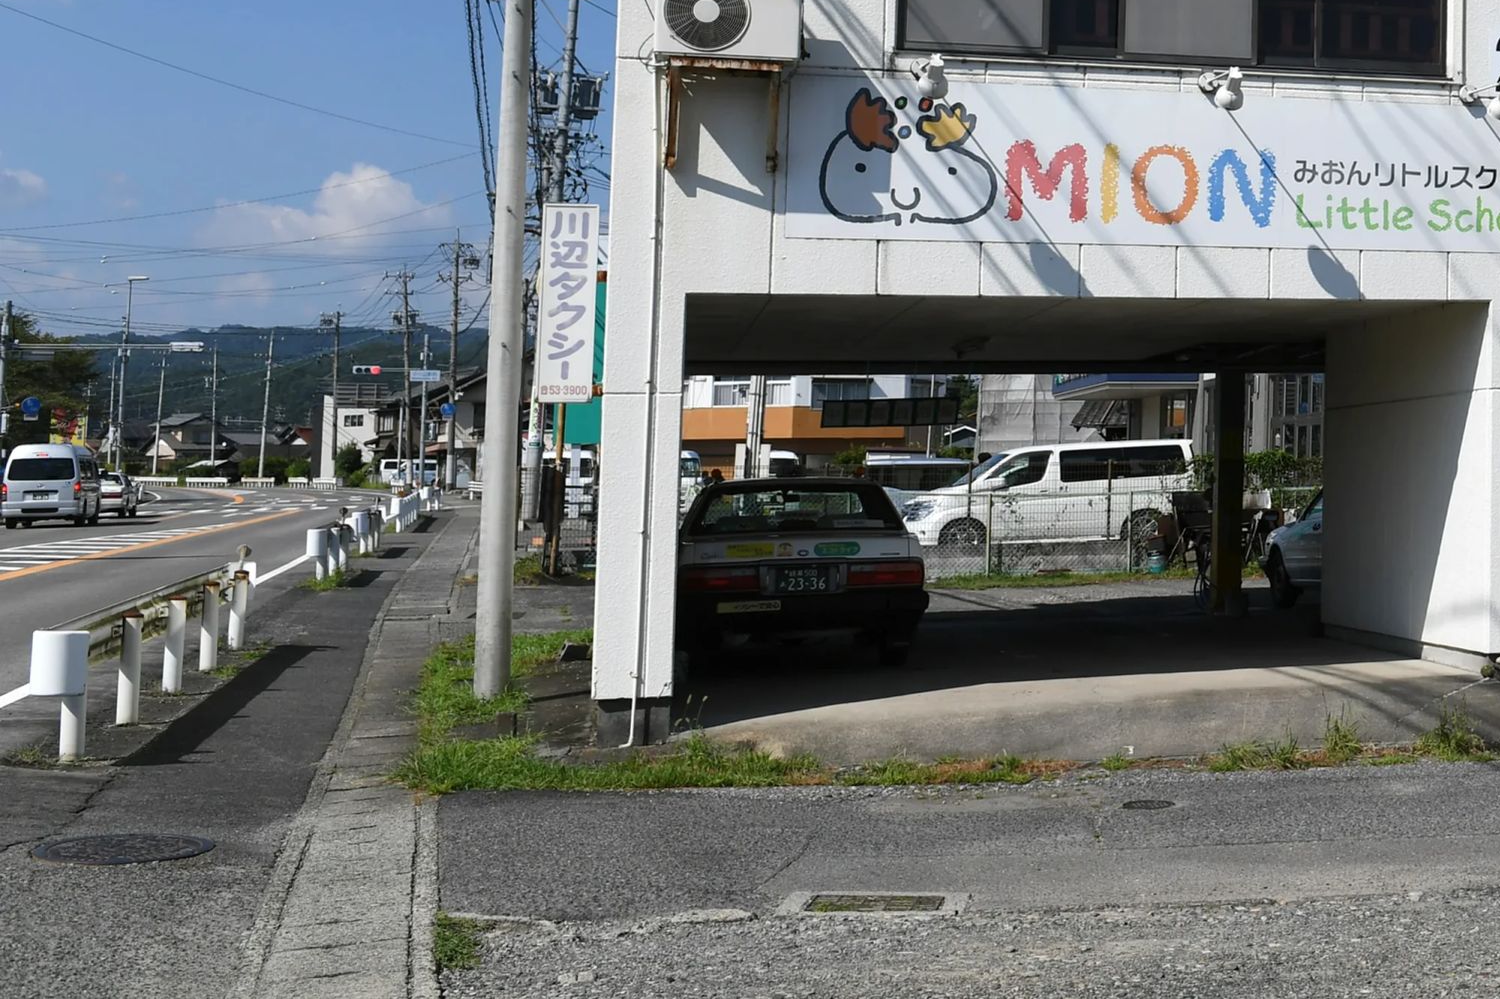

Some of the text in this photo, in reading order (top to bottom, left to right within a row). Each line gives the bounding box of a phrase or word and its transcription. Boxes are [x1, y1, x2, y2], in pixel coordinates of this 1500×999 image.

[1004, 139, 1277, 228] MION
[1295, 193, 1414, 231] Little
[547, 210, 591, 381] 川辺タクシー
